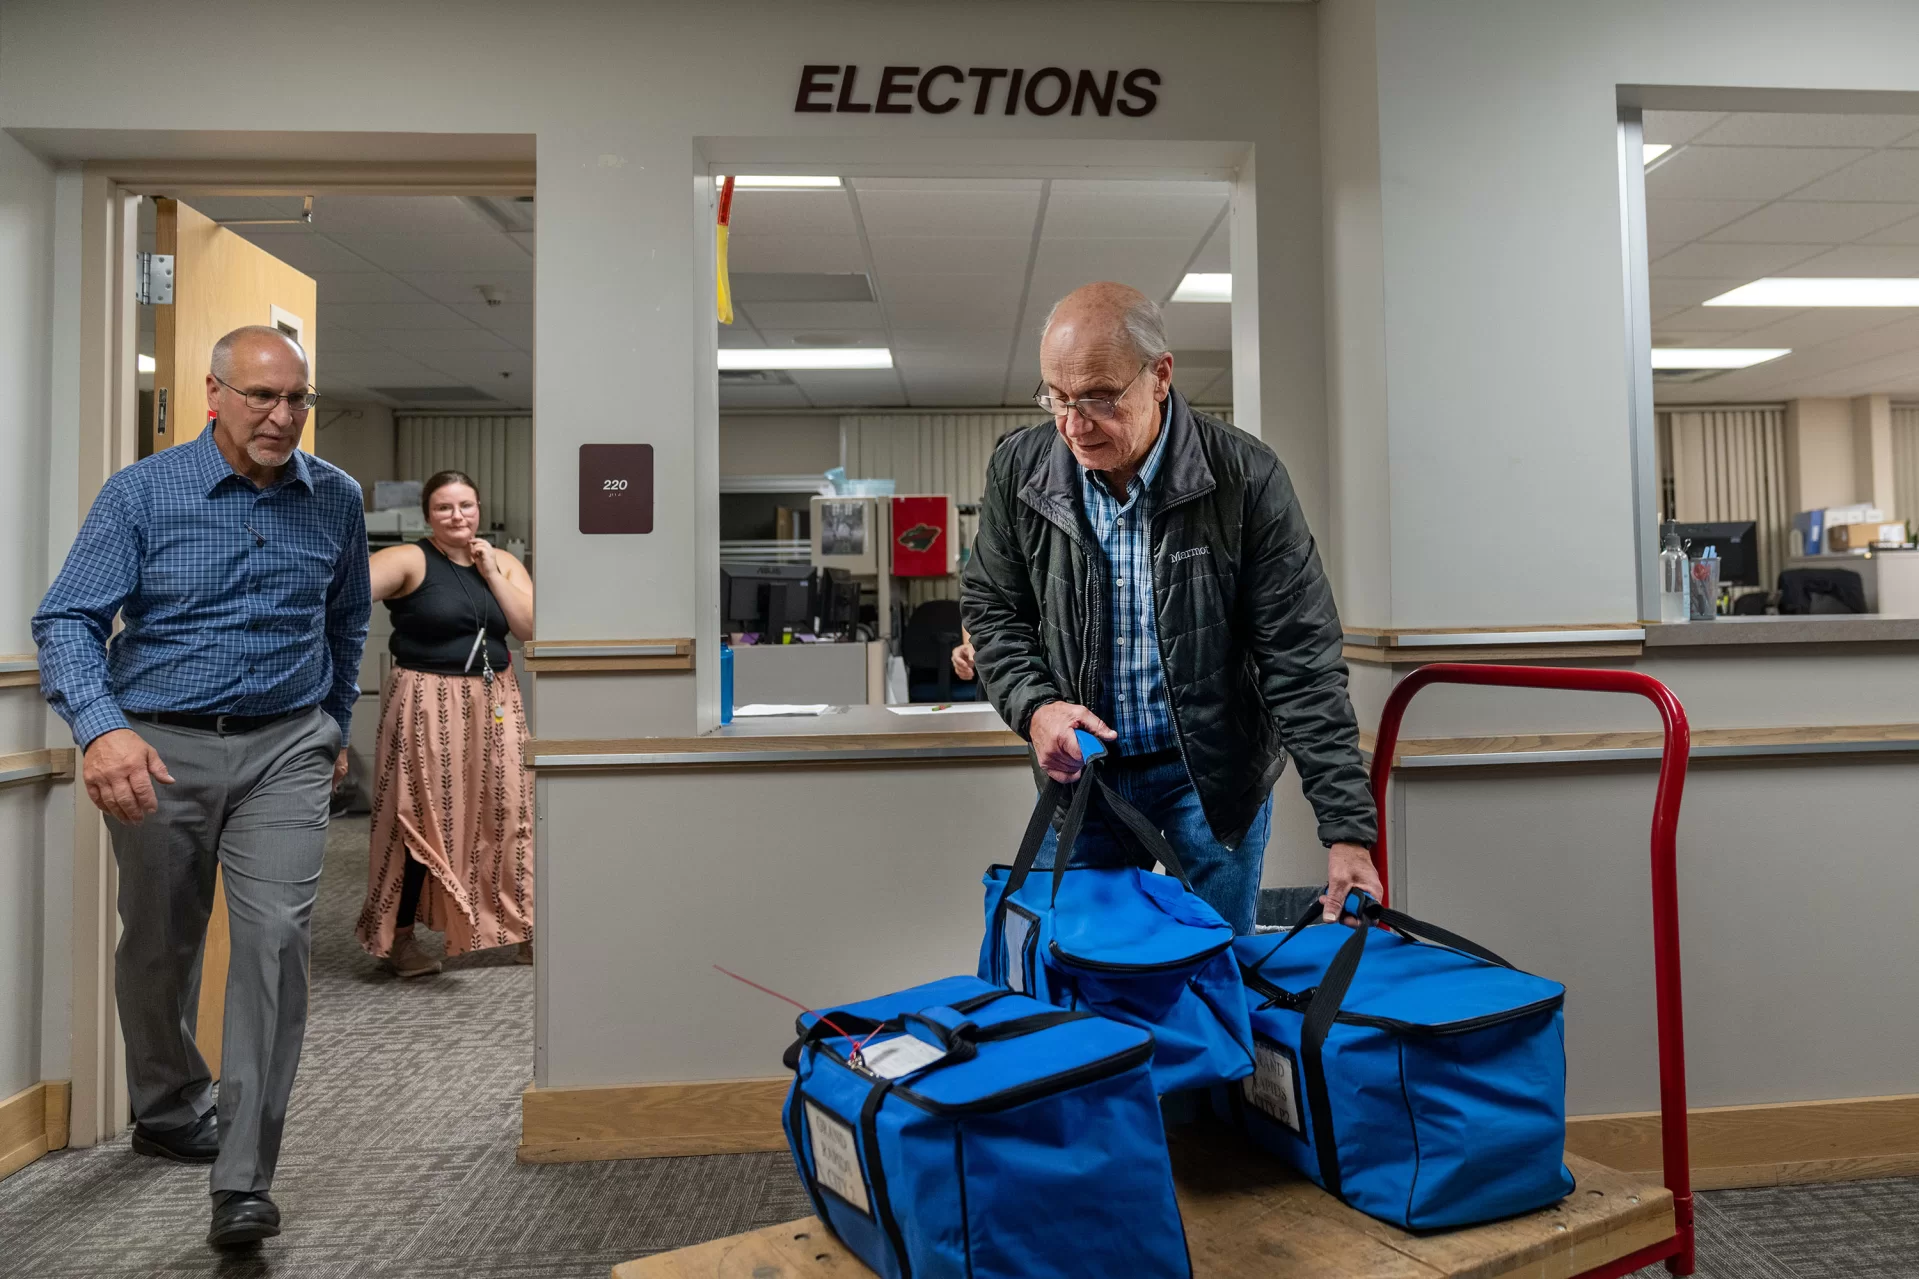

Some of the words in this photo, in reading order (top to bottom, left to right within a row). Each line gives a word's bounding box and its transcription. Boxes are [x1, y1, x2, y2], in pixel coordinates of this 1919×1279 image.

[795, 65, 1161, 117] ELECTIONS
[603, 479, 628, 490] 220
[1169, 545, 1210, 563] Marmot
[1255, 1049, 1284, 1078] RAND
